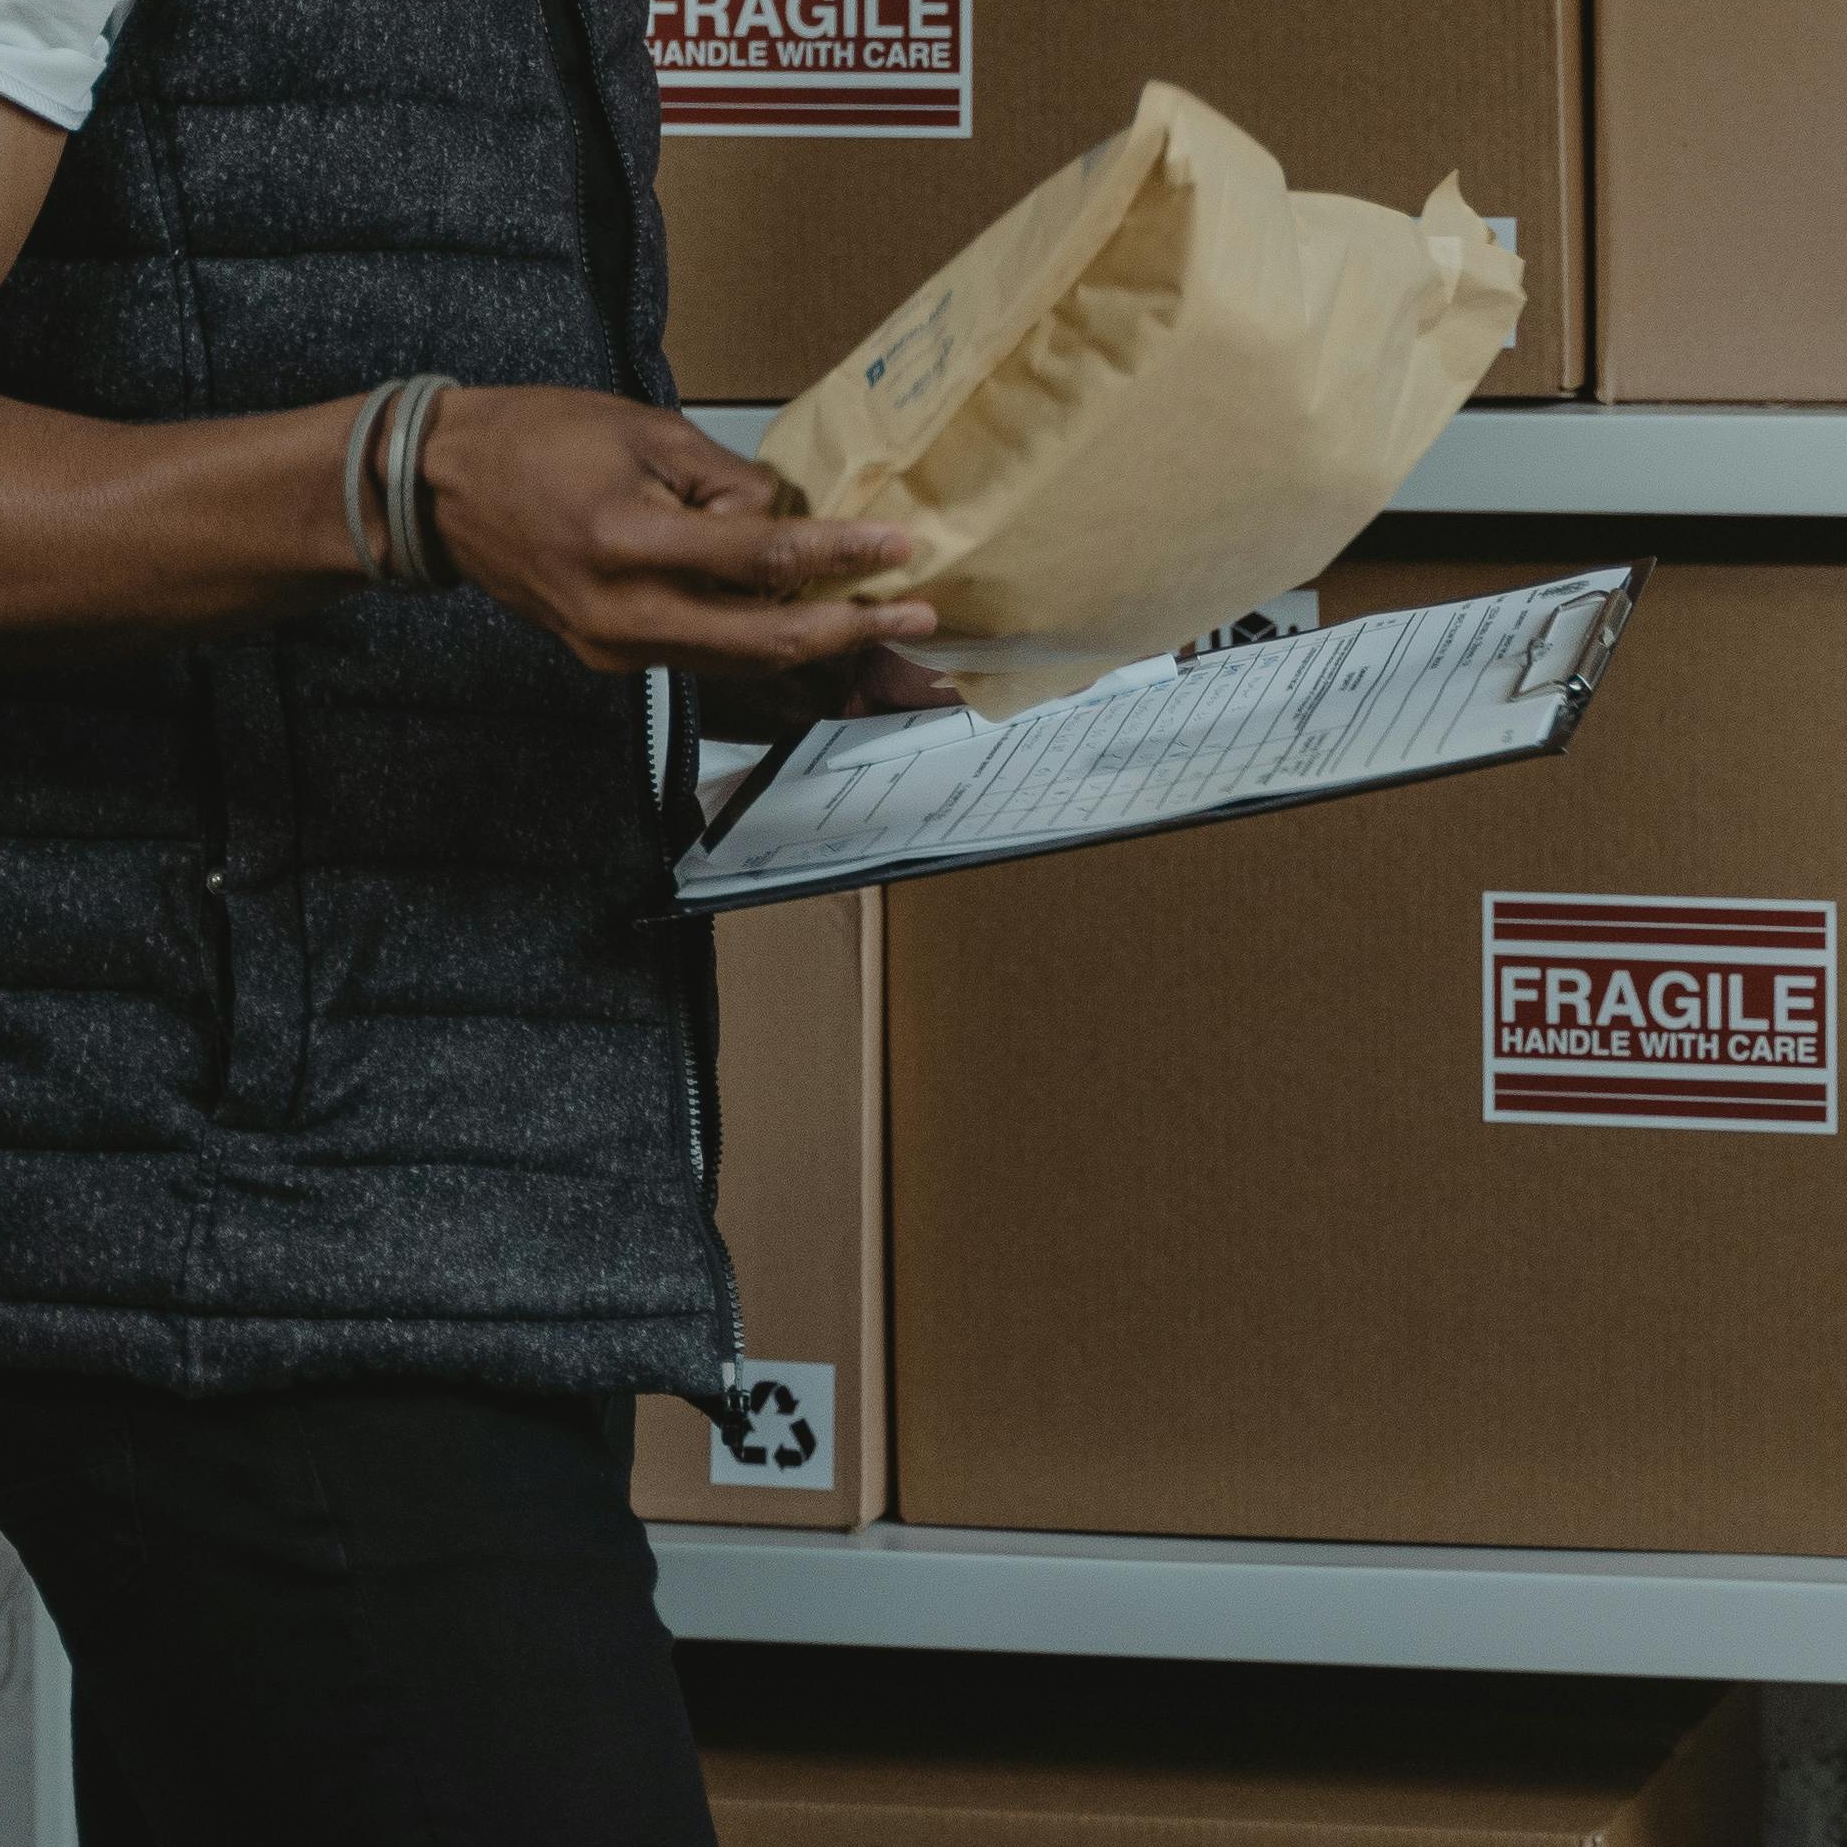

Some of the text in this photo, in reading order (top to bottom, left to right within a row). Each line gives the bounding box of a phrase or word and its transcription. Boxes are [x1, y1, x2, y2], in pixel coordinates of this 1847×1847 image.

[644, 39, 952, 70] HANDLE WITH CARE
[1500, 966, 1818, 1034] FRAGILE
[1501, 1027, 1818, 1064] HANDLE WITH CARE
